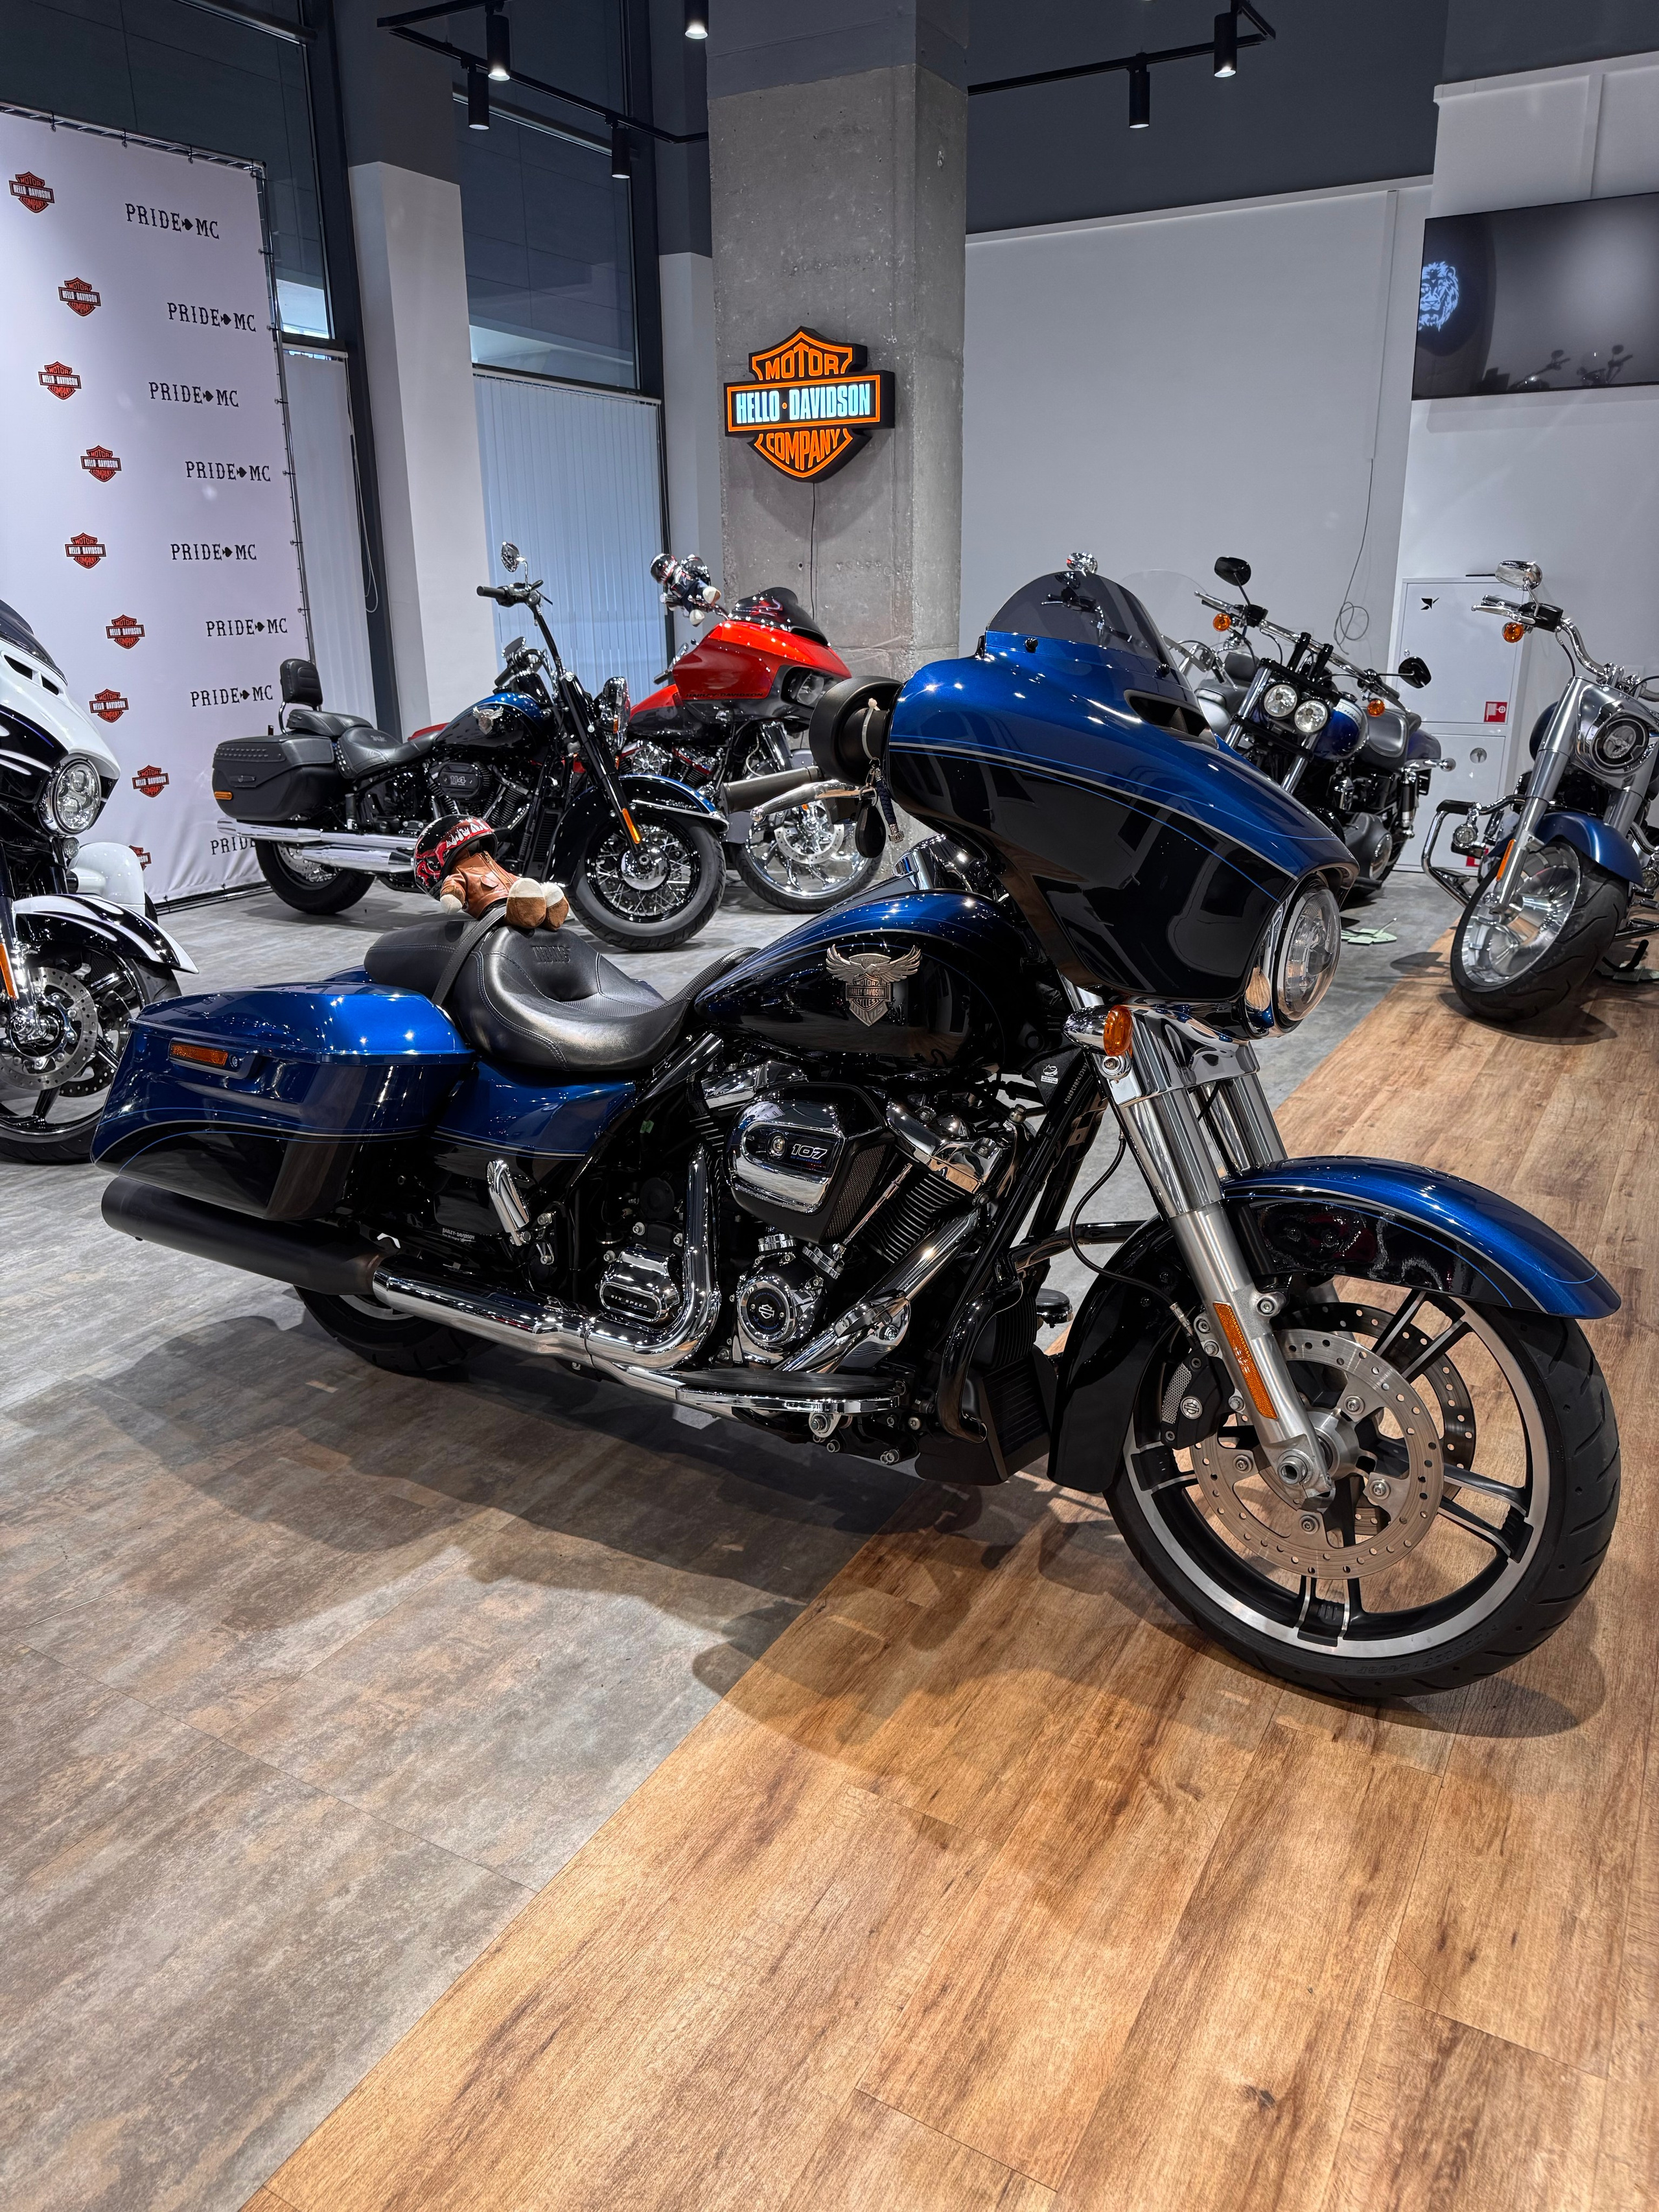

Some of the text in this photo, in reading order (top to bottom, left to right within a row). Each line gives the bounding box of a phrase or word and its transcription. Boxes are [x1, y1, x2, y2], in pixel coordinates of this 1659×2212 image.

[20, 175, 41, 187] MOTOR
[13, 183, 51, 200] HELLO DAVIDSON
[23, 198, 44, 210] COMPANY
[125, 204, 219, 239] PRIDE MC
[69, 281, 89, 292] MOTOR
[62, 290, 98, 303] HELLO DAVIDSON
[167, 303, 256, 332] PRIDE MC
[765, 342, 839, 380] MOTOR
[49, 365, 69, 375] MOTOR
[41, 375, 78, 386] HELLO DAVIDSON
[148, 382, 238, 407] PRIDE MC
[736, 383, 871, 424] HELLO DAVIDSON
[91, 448, 110, 458] MOTOR
[766, 428, 841, 471] COMPANY
[185, 461, 270, 482] PRIDE MC
[75, 536, 94, 544] MOTOR
[170, 544, 257, 560] PRIDE MC
[115, 618, 133, 626] MOTOR
[206, 618, 287, 636] PRIDE MC
[99, 692, 117, 701] MOTOR
[191, 685, 273, 707] PRIDE MC
[450, 775, 467, 784] 114
[856, 978, 876, 986] MOTOR
[848, 988, 885, 997] HARLEY-DAVIDSON
[856, 999, 876, 1008] CYCLES
[791, 1143, 828, 1160] 107
[625, 1299, 647, 1309] SPEED
